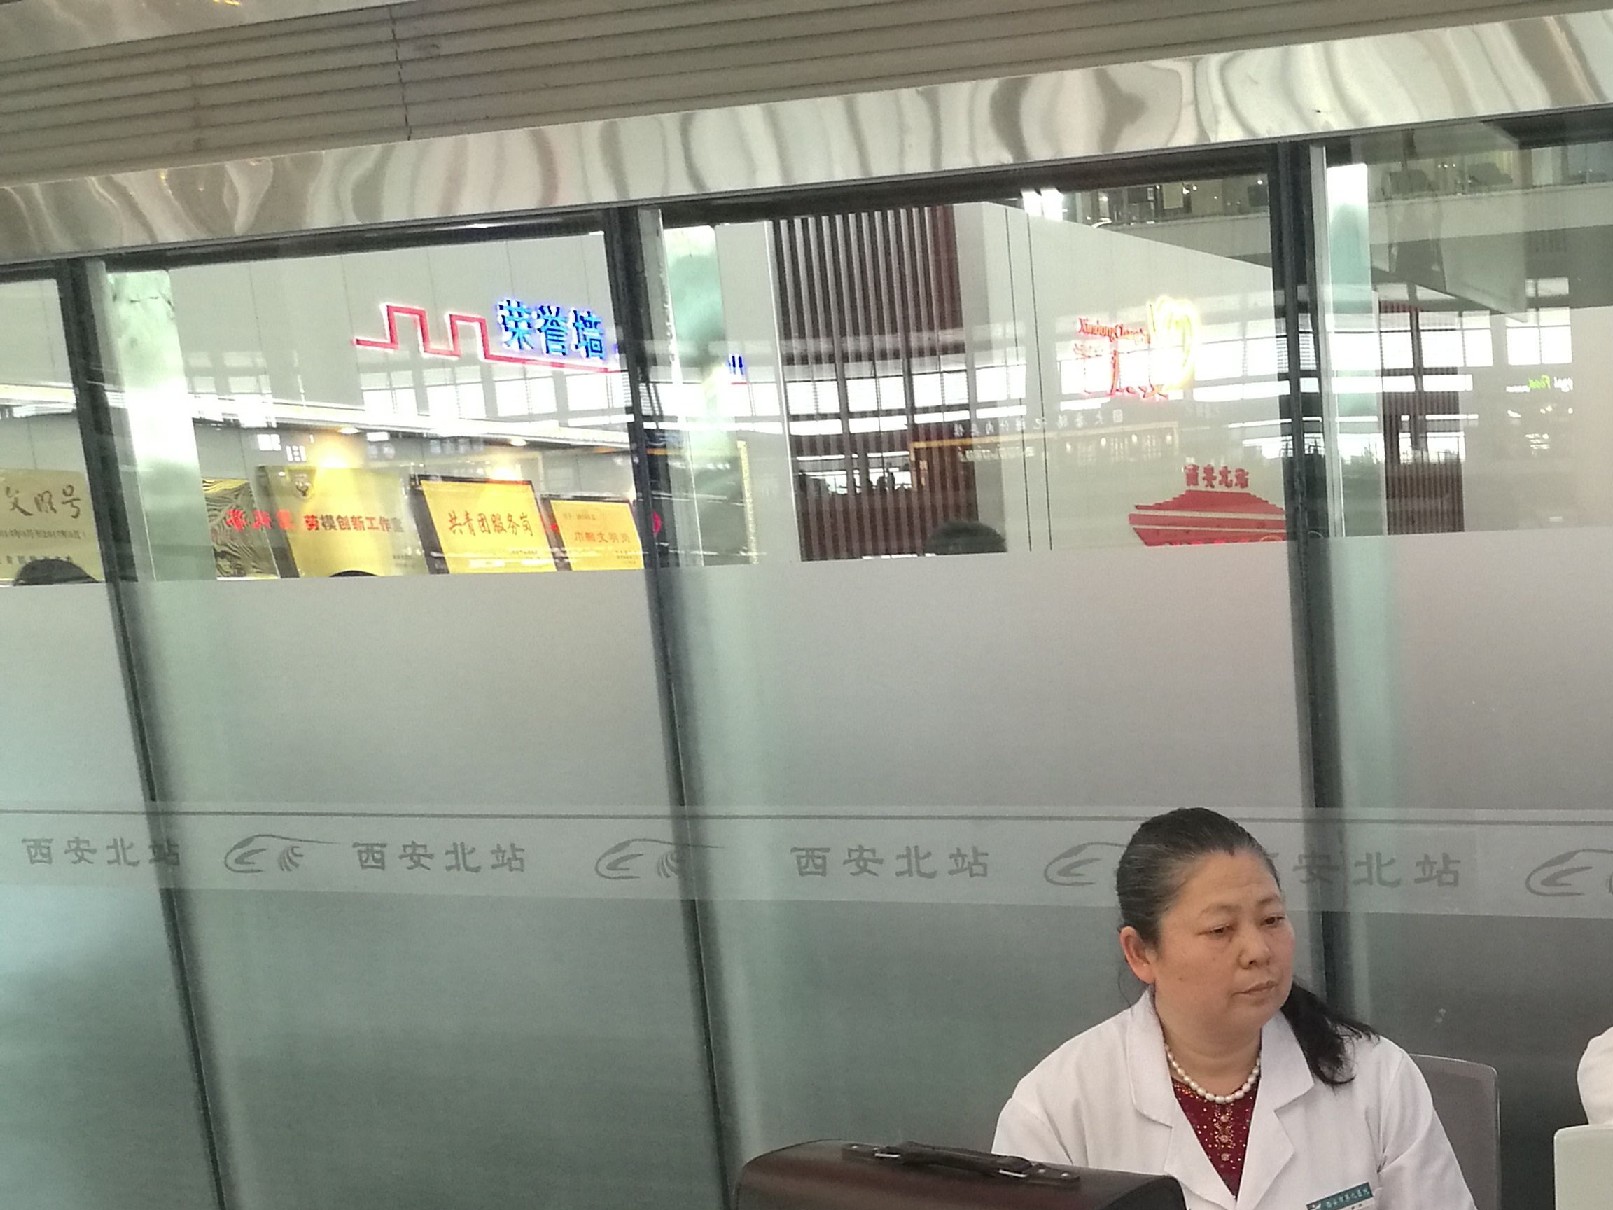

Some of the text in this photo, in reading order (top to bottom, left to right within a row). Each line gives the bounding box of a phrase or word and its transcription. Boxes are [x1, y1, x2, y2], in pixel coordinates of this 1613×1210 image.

[496, 299, 605, 360] 荣誉墙
[22, 836, 181, 869] 西安北站
[351, 841, 527, 874] 西安北站
[789, 843, 994, 880] 西安北站
[1266, 850, 1462, 889] 安北站
